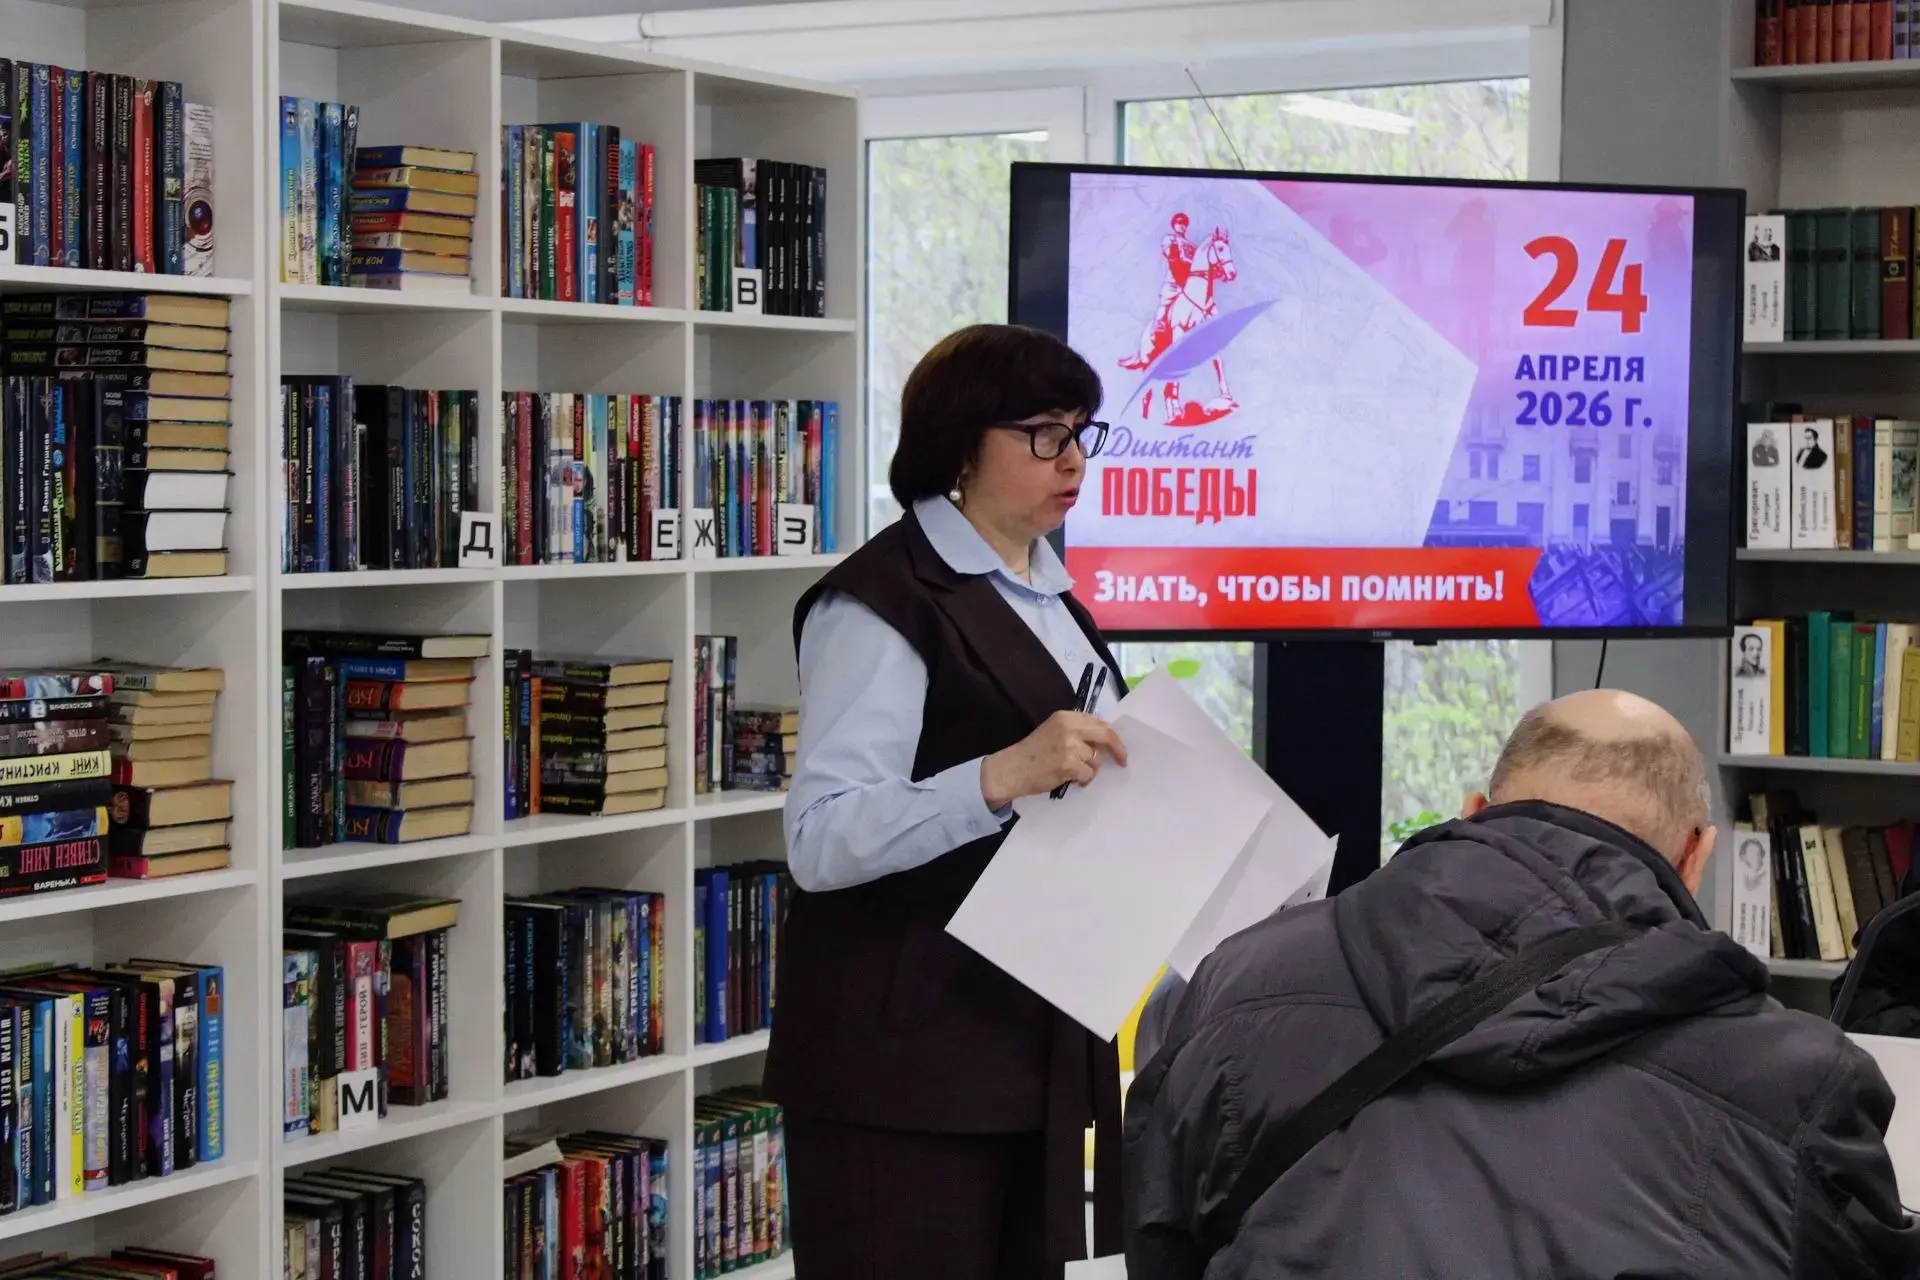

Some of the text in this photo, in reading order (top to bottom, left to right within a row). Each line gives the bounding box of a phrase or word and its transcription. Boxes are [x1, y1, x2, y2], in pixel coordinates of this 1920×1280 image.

[738, 278, 757, 304] В
[1523, 236, 1648, 333] 24
[1515, 354, 1644, 382] АПРЕЛЯ
[1515, 390, 1613, 427] 2026
[1104, 426, 1257, 459] Диктант
[305, 474, 313, 505] Евгений
[1102, 467, 1257, 525] ПОБЕДЫ
[1749, 480, 1759, 541] Григорович
[1798, 485, 1808, 538] Грибоедов
[463, 521, 494, 559] Д
[657, 520, 673, 547] Е
[694, 519, 715, 546] Ж
[784, 517, 806, 545] З
[1217, 574, 1330, 602] ЧТОБЫ
[1341, 569, 1504, 601] ПОМНИТЬ!
[70, 757, 99, 774] КИНГ
[19, 840, 100, 875] СТИВЕН КИНГ
[33, 877, 77, 891] ВАРЕНЬКА
[630, 961, 638, 1016] ТРЕПЕТ
[1, 1018, 12, 1107] ШТОРМ СВЕТА
[342, 1079, 374, 1115] М
[411, 1203, 421, 1279] СОКОЛ
